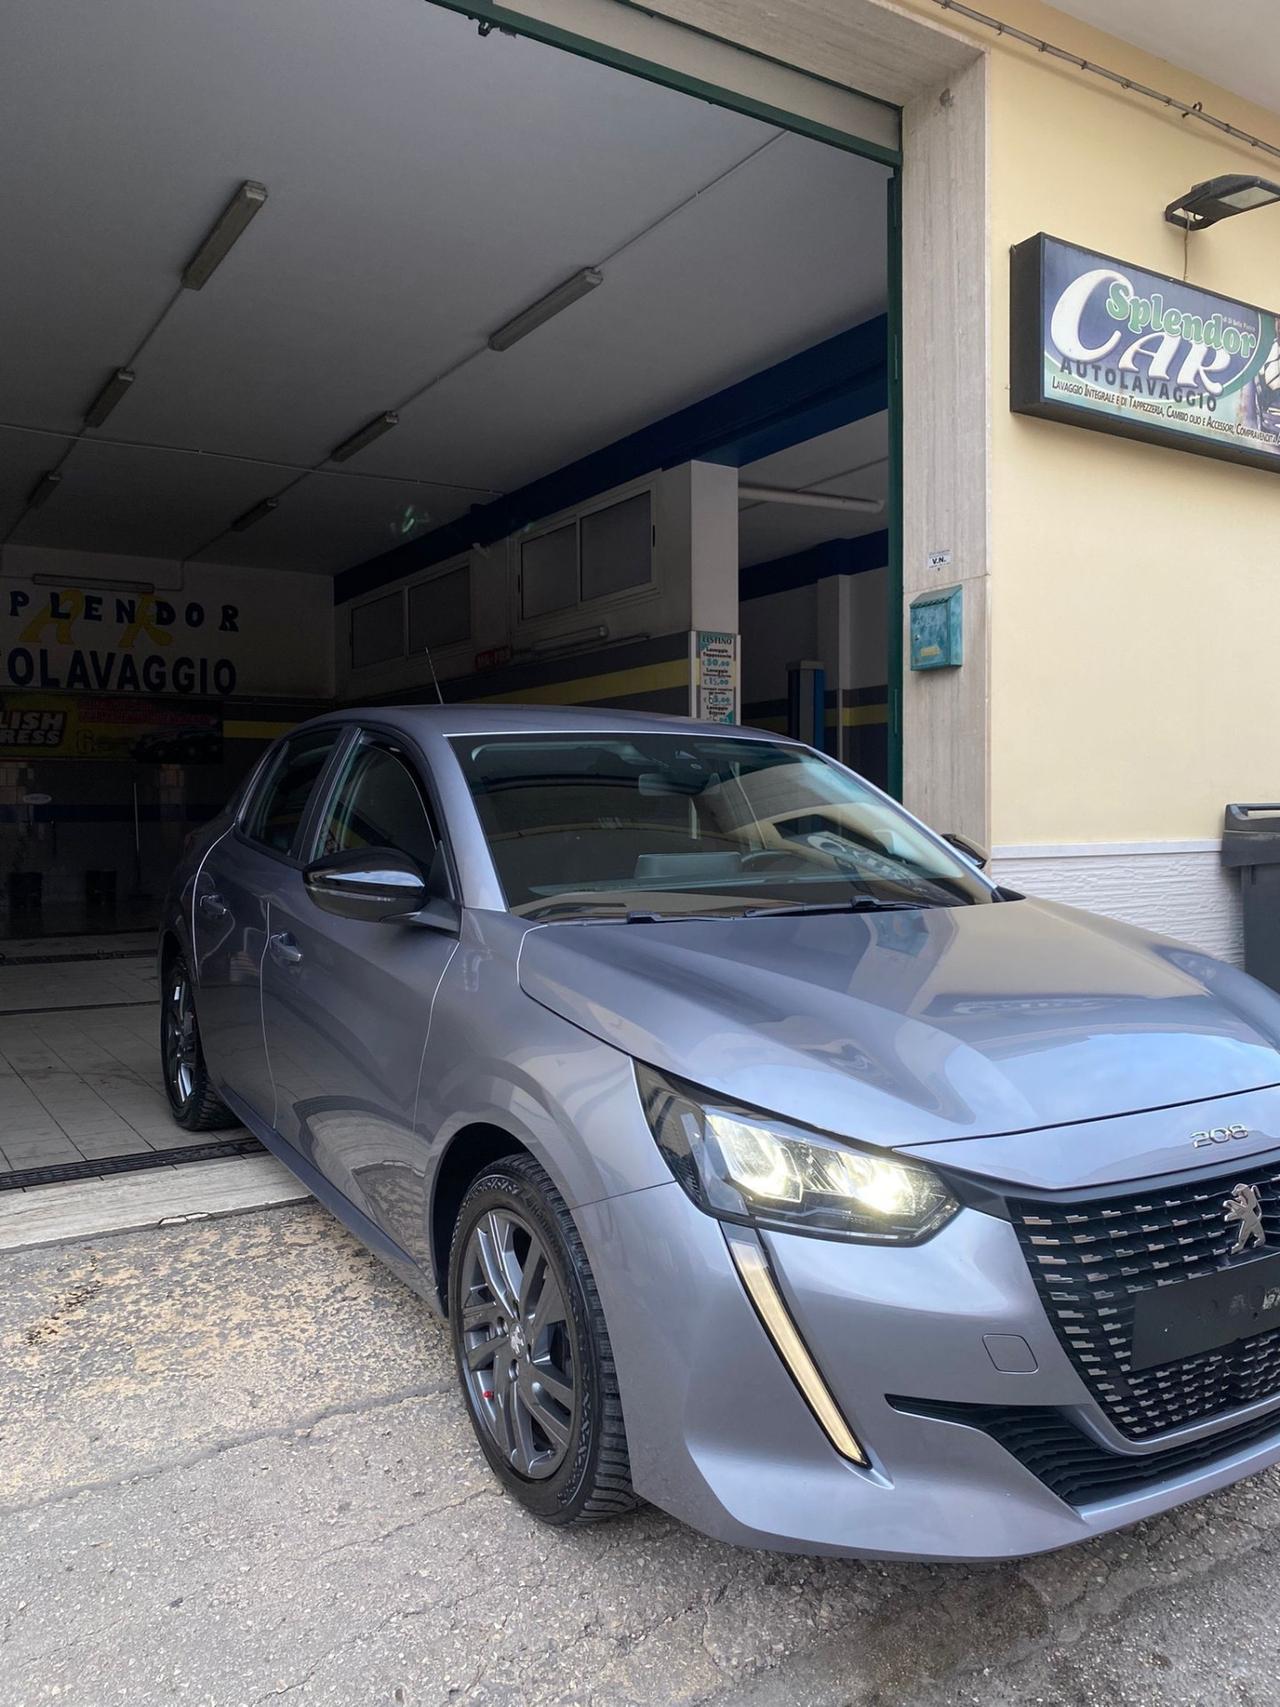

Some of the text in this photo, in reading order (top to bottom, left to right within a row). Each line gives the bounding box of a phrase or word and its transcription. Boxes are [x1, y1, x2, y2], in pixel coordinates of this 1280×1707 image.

[1050, 268, 1231, 396] CAR
[1105, 280, 1257, 358] Splendor
[1060, 356, 1217, 412] AUTOLAVAGGIO
[702, 635, 732, 645] LISTINO
[1190, 1123, 1249, 1149] 208
